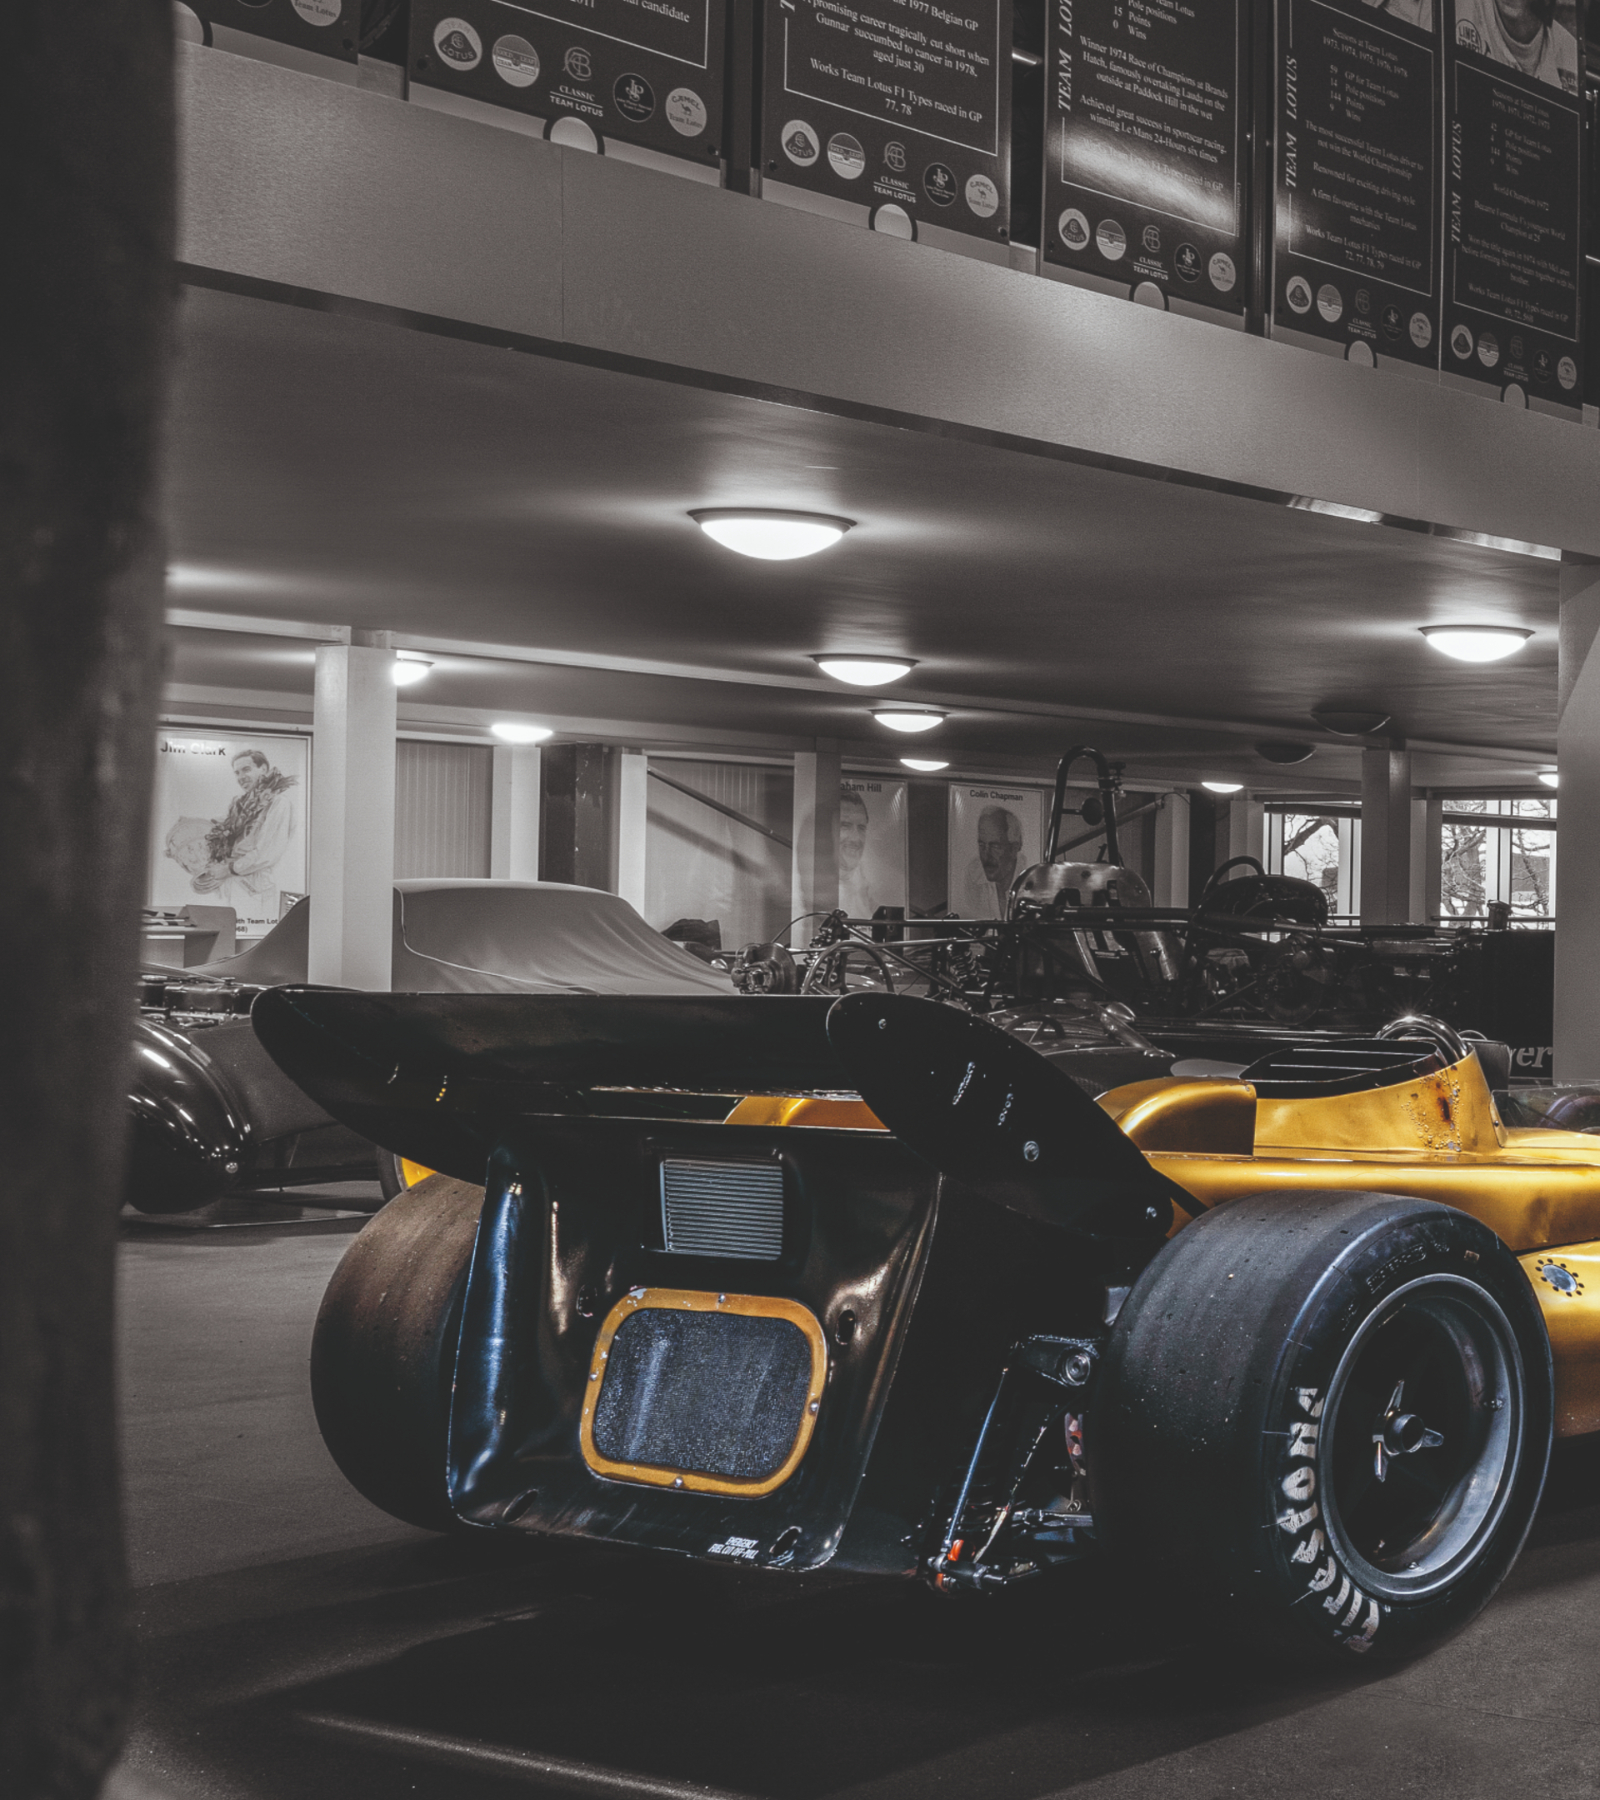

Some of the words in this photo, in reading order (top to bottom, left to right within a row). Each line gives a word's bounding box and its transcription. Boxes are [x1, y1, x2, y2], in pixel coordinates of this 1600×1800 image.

[641, 0, 689, 22] candidate
[931, 6, 962, 25] Belgian
[964, 19, 978, 30] GP
[816, 12, 849, 31] Gunnar
[854, 28, 902, 50] succumbed
[904, 44, 913, 53] to
[914, 44, 942, 63] cancer
[944, 55, 952, 67] in
[859, 14, 886, 29] career
[888, 23, 926, 45] tragically
[929, 39, 943, 49] cut
[945, 42, 965, 57] short
[967, 51, 989, 65] when
[442, 44, 475, 60] LOTUS
[873, 50, 893, 63] aged
[894, 54, 911, 69] just
[913, 60, 924, 73] 30
[1079, 35, 1107, 53] Winner
[1109, 46, 1126, 60] 1974
[1128, 53, 1146, 68] Race
[1156, 64, 1195, 85] Champions
[1204, 82, 1228, 98] Brands
[810, 57, 839, 76] Works
[841, 67, 865, 84] Team
[867, 76, 892, 93] Lotus
[894, 85, 904, 97] F1
[908, 90, 932, 106] Types
[934, 101, 956, 115] raced
[958, 106, 966, 118] in
[968, 110, 982, 122] GP
[1058, 48, 1072, 112] TEAM
[1286, 55, 1298, 120] LOTUS
[559, 84, 595, 101] CLASSIC
[671, 95, 701, 111] CAMEL
[550, 95, 574, 109] TEAM
[575, 103, 604, 117] LOTUS
[1285, 131, 1297, 188] TEAM
[1451, 120, 1462, 181] LOTUS
[873, 185, 892, 197] TEAM
[893, 191, 917, 204] LOTUS
[880, 175, 910, 190] CLASSIC
[1451, 191, 1462, 243] TEAM
[840, 782, 865, 793] aham
[866, 783, 882, 793] Hill
[969, 789, 988, 799] Colin
[990, 791, 1024, 802] Chapman
[1276, 1384, 1381, 1655] Firestone
